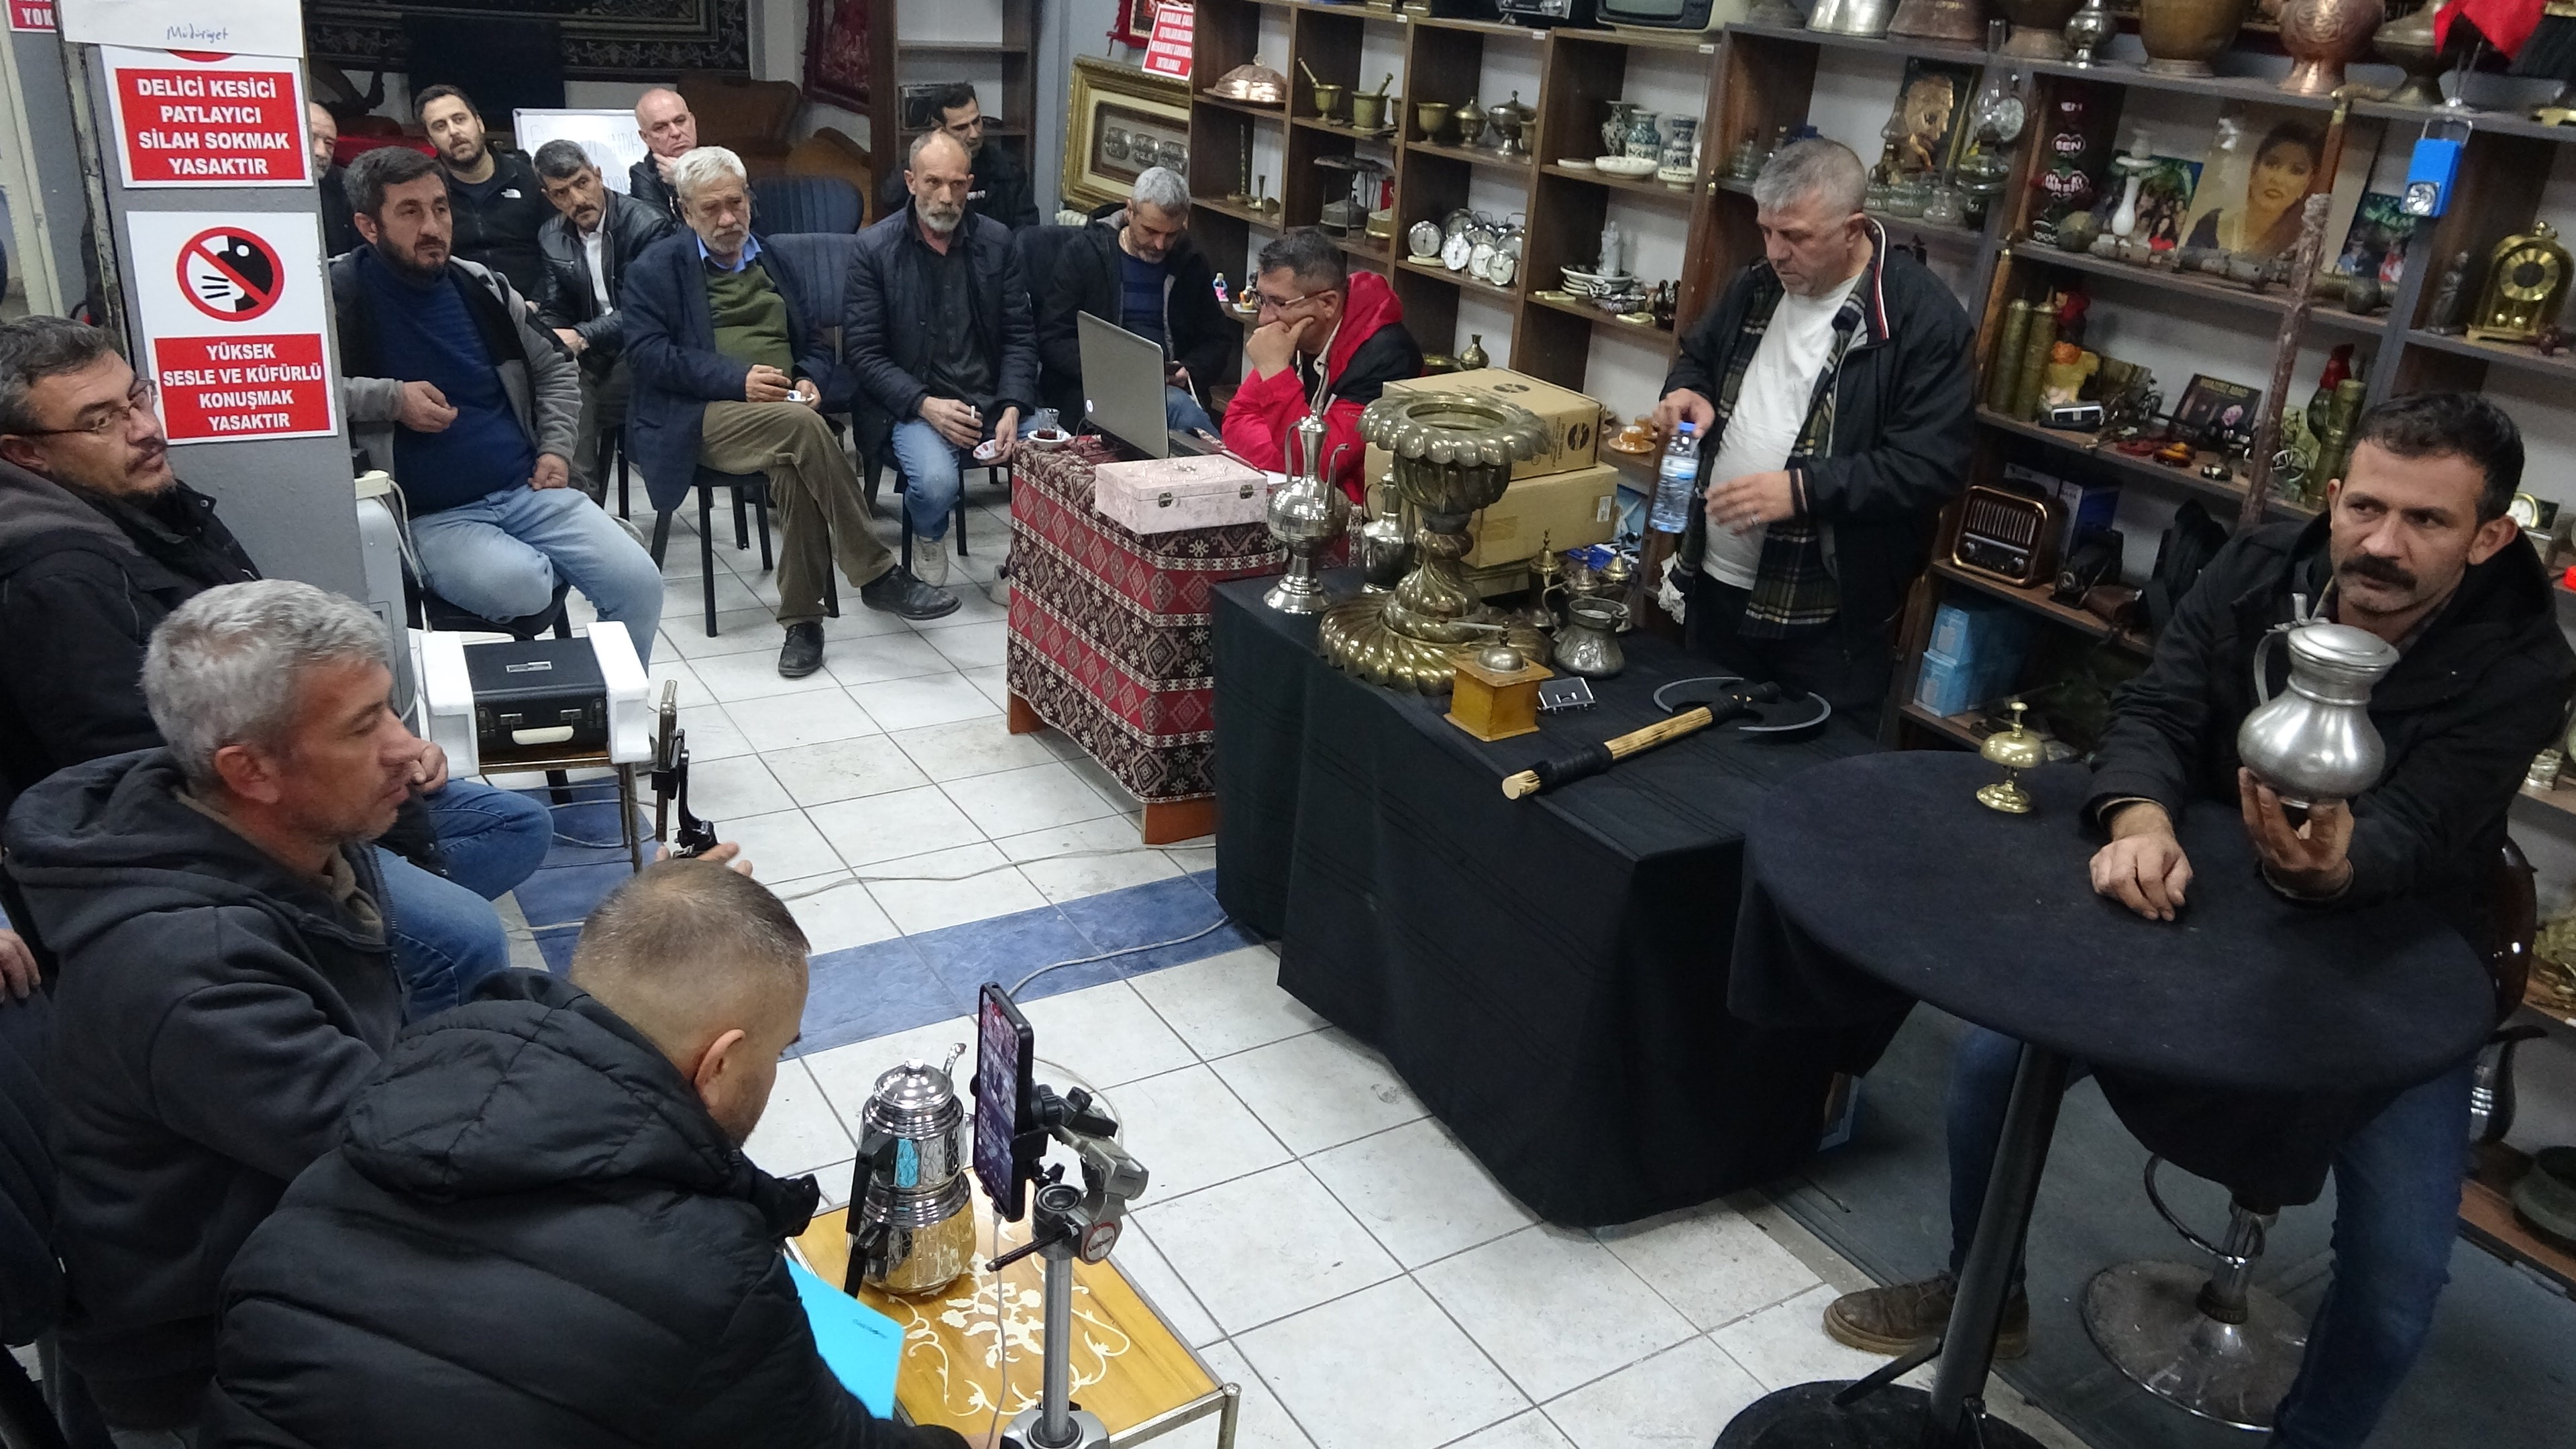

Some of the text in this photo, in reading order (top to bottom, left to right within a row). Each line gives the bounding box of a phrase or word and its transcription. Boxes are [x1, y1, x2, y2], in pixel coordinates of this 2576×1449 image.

[137, 75, 276, 99] DELİCİ KESİCİ
[160, 105, 262, 124] PATLAYICI
[138, 128, 290, 149] SİLAH SOKMAK
[168, 158, 269, 175] YASAKTIR
[205, 341, 276, 361] YÜKSEK
[162, 362, 322, 386] SESLE VE KÜFÜRLÜ
[199, 390, 294, 410] KONUŞMAK
[208, 413, 291, 431] YASAKTIR
